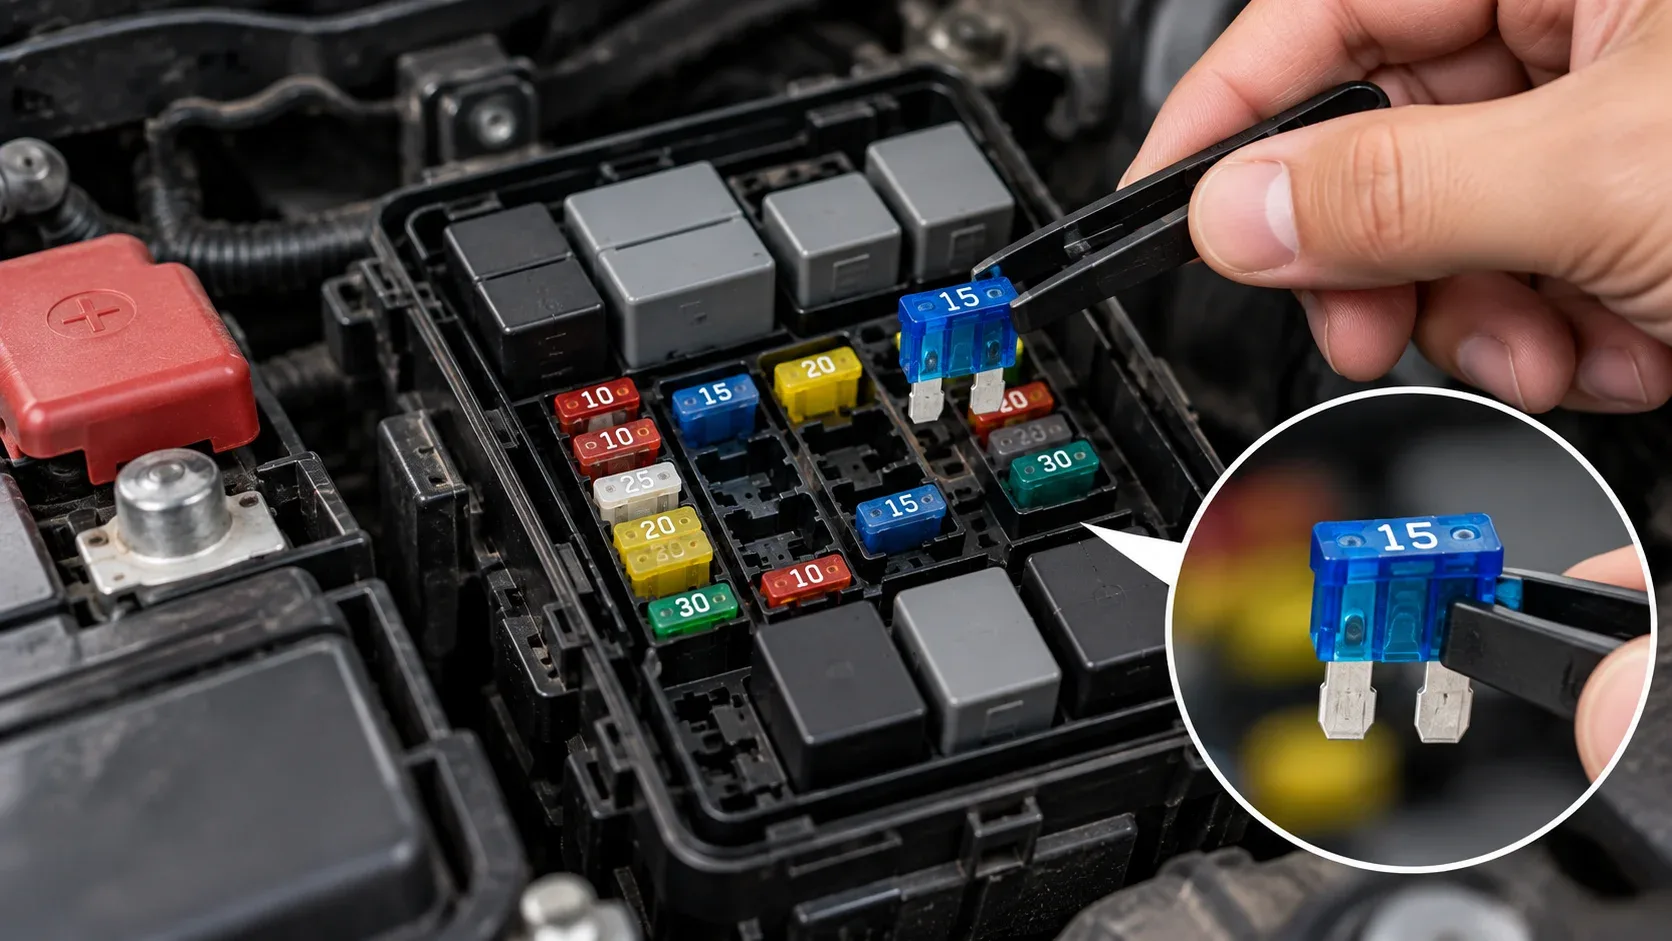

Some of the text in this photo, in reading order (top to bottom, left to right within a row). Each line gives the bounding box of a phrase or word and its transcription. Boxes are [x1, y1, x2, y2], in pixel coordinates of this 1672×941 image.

[939, 286, 980, 312] 15
[801, 355, 836, 379] 20
[581, 386, 614, 409] 10
[699, 382, 733, 406] 15
[600, 427, 634, 450] 10
[1037, 449, 1072, 473] 30
[620, 470, 654, 494] 25
[884, 493, 919, 518] 15
[640, 515, 676, 540] 20
[1377, 521, 1439, 552] 15
[789, 564, 824, 588] 10
[675, 592, 711, 618] 30
